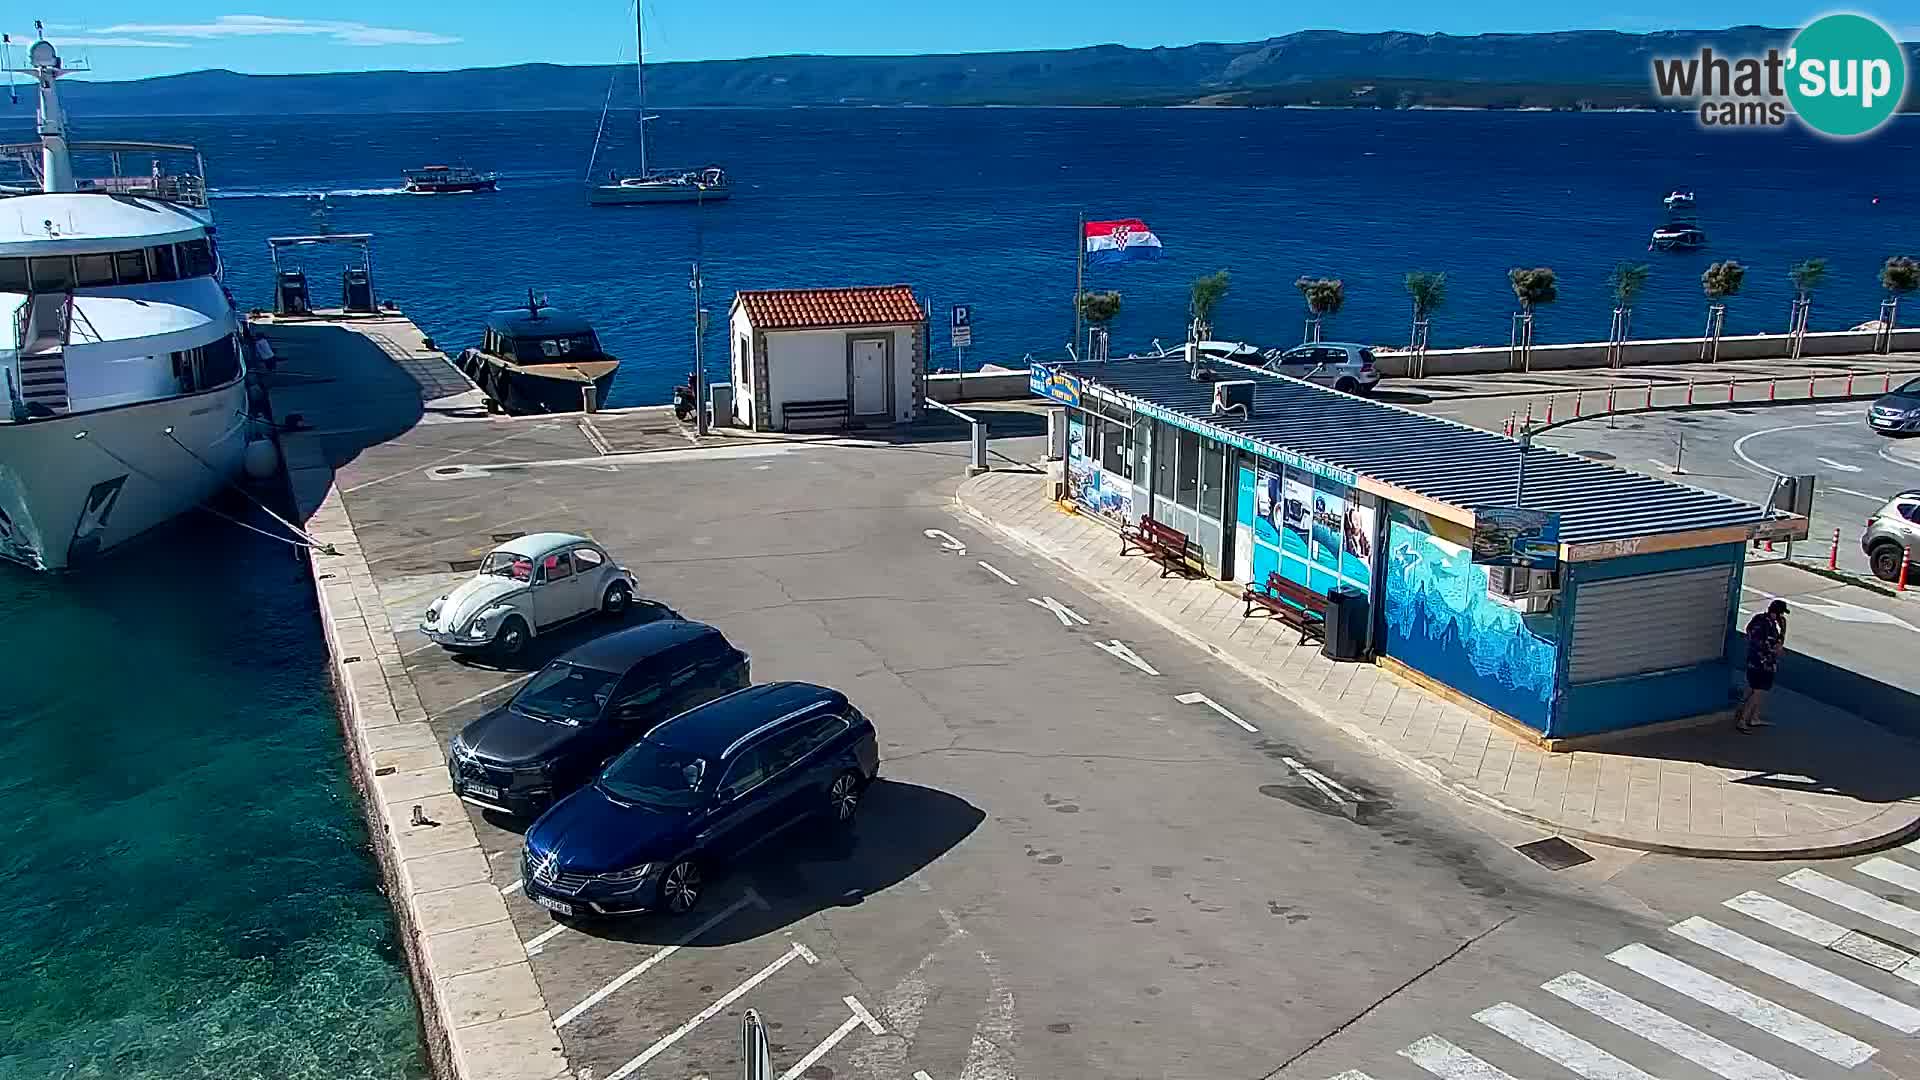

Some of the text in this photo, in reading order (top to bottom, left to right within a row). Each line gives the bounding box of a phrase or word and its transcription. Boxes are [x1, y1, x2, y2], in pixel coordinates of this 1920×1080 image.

[956, 307, 967, 325] P
[1253, 444, 1268, 456] BUS
[1268, 448, 1299, 465] STATION
[1301, 458, 1325, 474] TICKET
[1326, 467, 1352, 483] OFFICE
